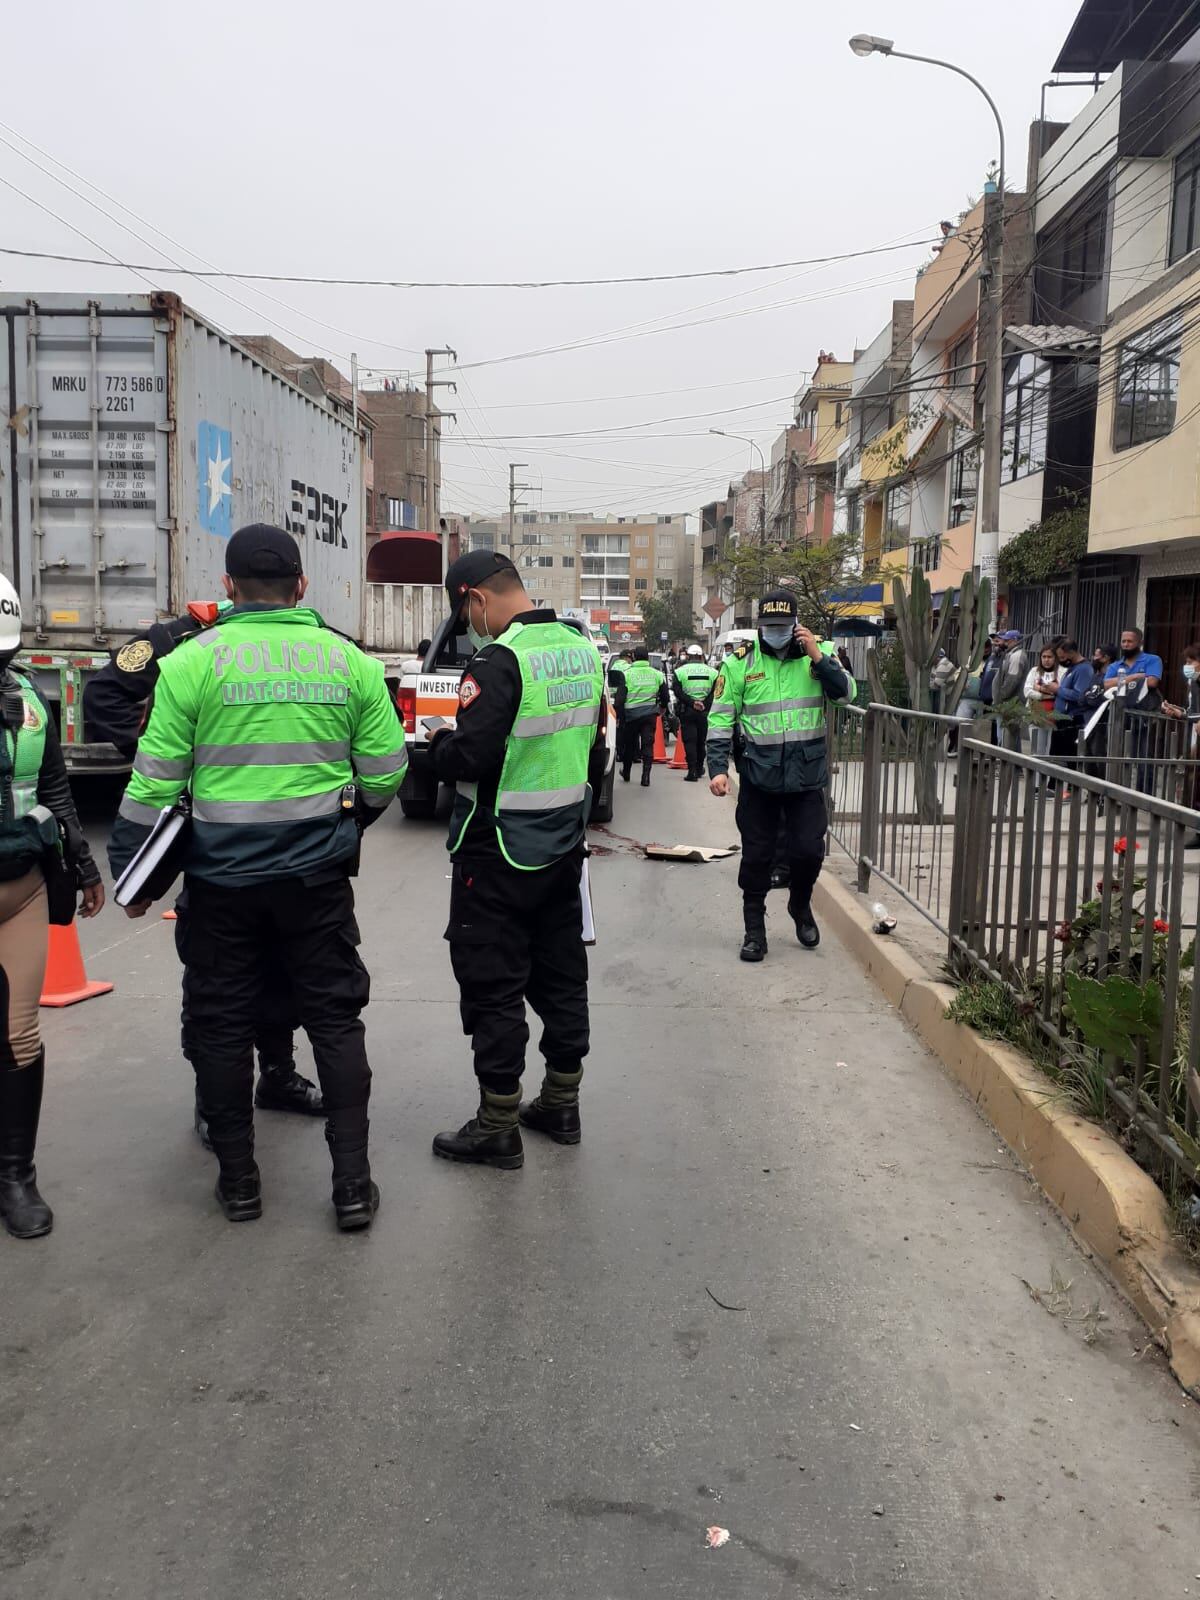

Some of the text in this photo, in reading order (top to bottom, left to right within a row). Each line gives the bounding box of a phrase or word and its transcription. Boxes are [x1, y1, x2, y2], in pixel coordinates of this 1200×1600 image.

[52, 376, 86, 391] MRKU
[105, 376, 127, 391] 773
[131, 377, 153, 392] 586
[106, 396, 134, 412] 22G1
[133, 432, 146, 441] KGS
[131, 451, 144, 459] KGS
[53, 470, 65, 479] NET
[133, 471, 146, 480] KGS
[285, 479, 349, 549] ERSK
[213, 640, 351, 677] POLICIA
[528, 649, 597, 680] POLICIA
[223, 681, 349, 702] UIAT-CENTRO
[548, 681, 593, 705] TRANSITO
[751, 709, 824, 733] POLICIA
